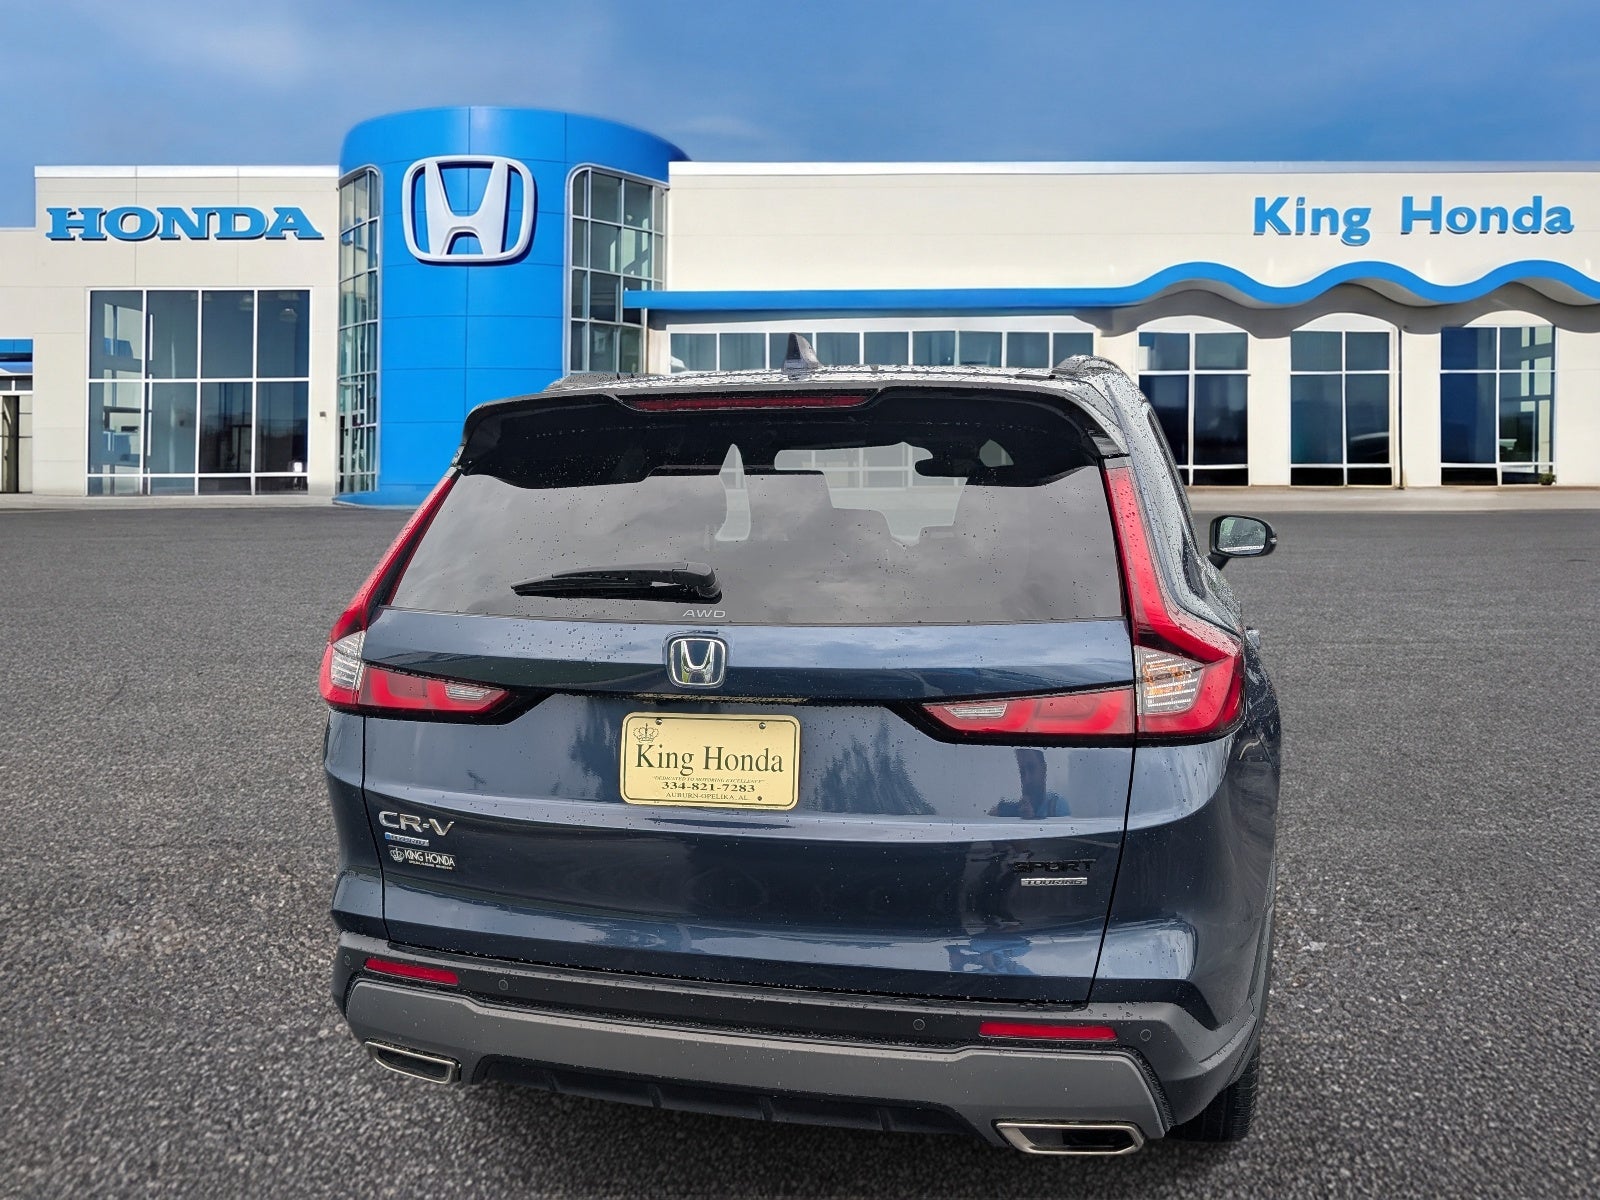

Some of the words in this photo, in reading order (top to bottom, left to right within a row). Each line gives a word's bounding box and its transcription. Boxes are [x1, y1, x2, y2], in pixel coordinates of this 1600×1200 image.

[45, 206, 325, 241] HONDA
[1253, 196, 1372, 246] King
[1400, 195, 1575, 235] Honda
[682, 609, 726, 618] AWD
[634, 743, 694, 776] King
[702, 745, 784, 772] Honda
[661, 781, 756, 793] 334-821-7283
[379, 811, 455, 836] CR-V
[404, 849, 424, 862] KING
[424, 852, 456, 867] HONDA
